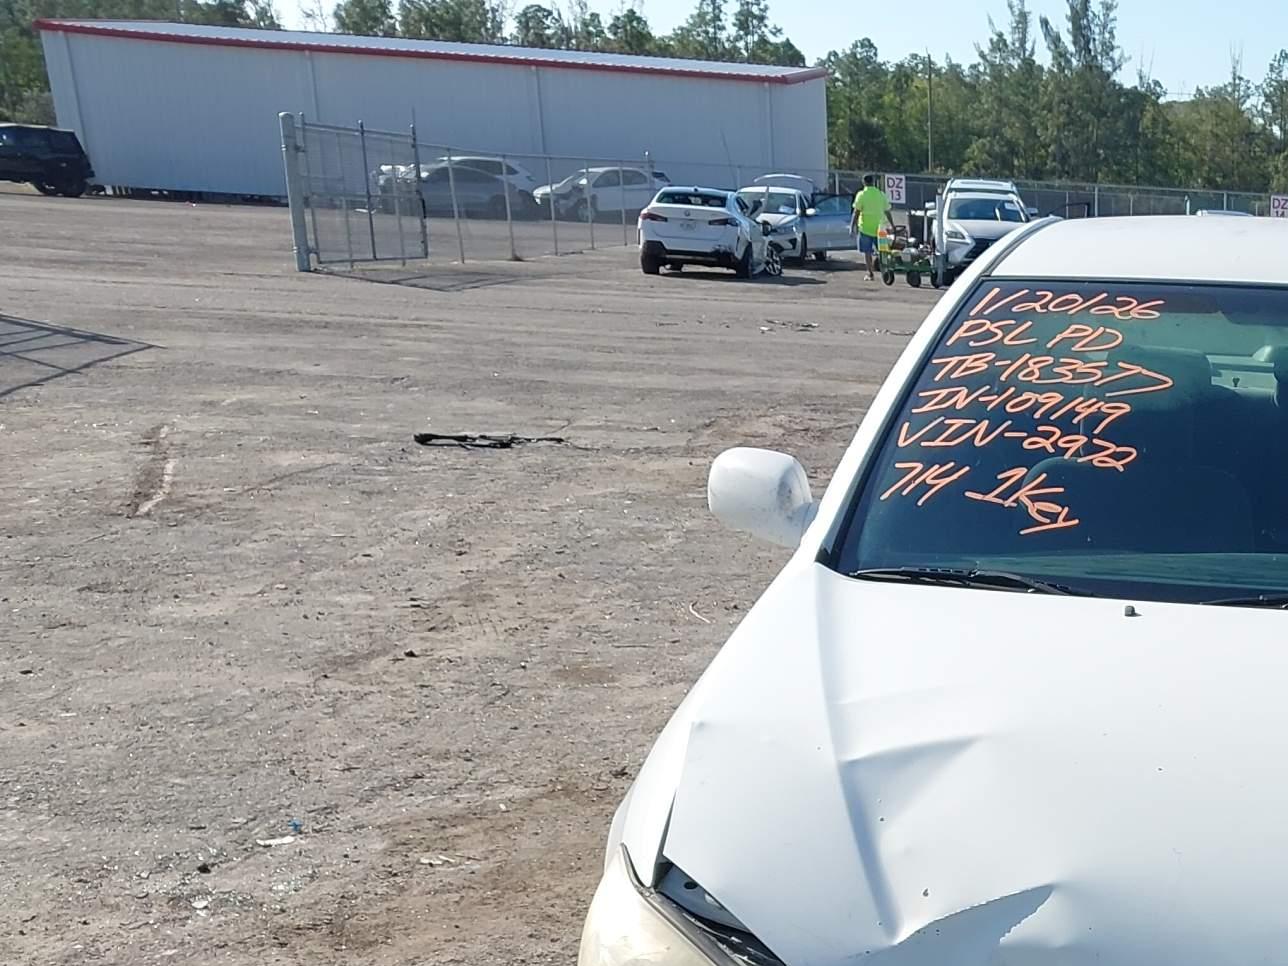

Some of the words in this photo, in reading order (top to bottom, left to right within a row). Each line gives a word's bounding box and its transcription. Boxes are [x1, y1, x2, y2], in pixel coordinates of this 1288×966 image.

[887, 177, 904, 189] DZ
[890, 189, 902, 201] 13
[1272, 198, 1288, 210] DZ
[969, 287, 1165, 320] 1/20/26
[946, 320, 1038, 348] PSL
[1046, 324, 1124, 352] PD
